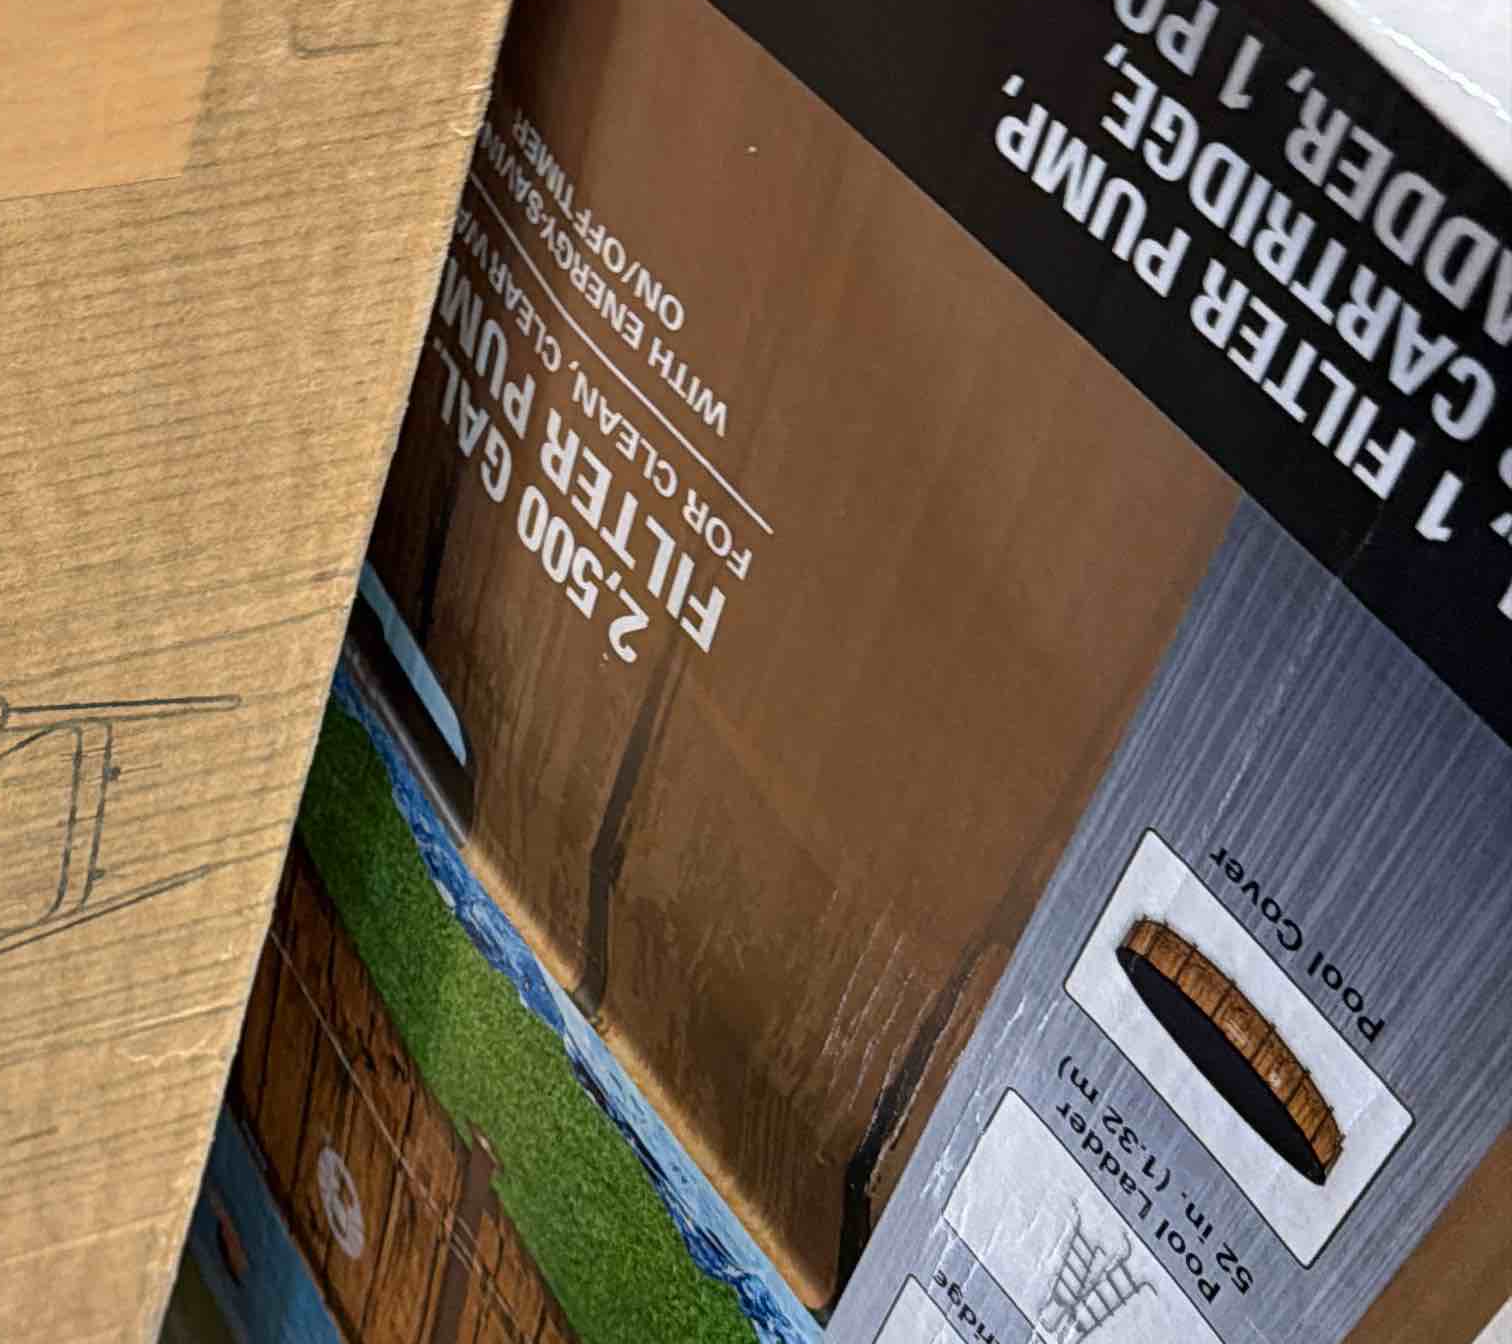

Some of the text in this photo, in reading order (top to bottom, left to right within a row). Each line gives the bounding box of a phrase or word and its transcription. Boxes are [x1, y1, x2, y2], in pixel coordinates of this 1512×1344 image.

[992, 72, 1192, 298] PUMP,
[1217, 34, 1266, 112] 1
[475, 119, 730, 438] WITH ENERGY-SAVIN
[1100, 43, 1498, 443] CARTRIDGE,
[439, 258, 727, 655] FILTER PUM
[568, 359, 680, 498] CLEAN,
[1188, 258, 1416, 501] FILTER
[431, 338, 650, 664] 2,500 GAL.
[682, 488, 754, 581] FOR
[1414, 469, 1463, 543] 1
[1209, 845, 1386, 1044] Pool Cover
[1053, 1102, 1223, 1305] Pool Ladder
[1055, 1054, 1255, 1297] 52 in. (1.32 m)
